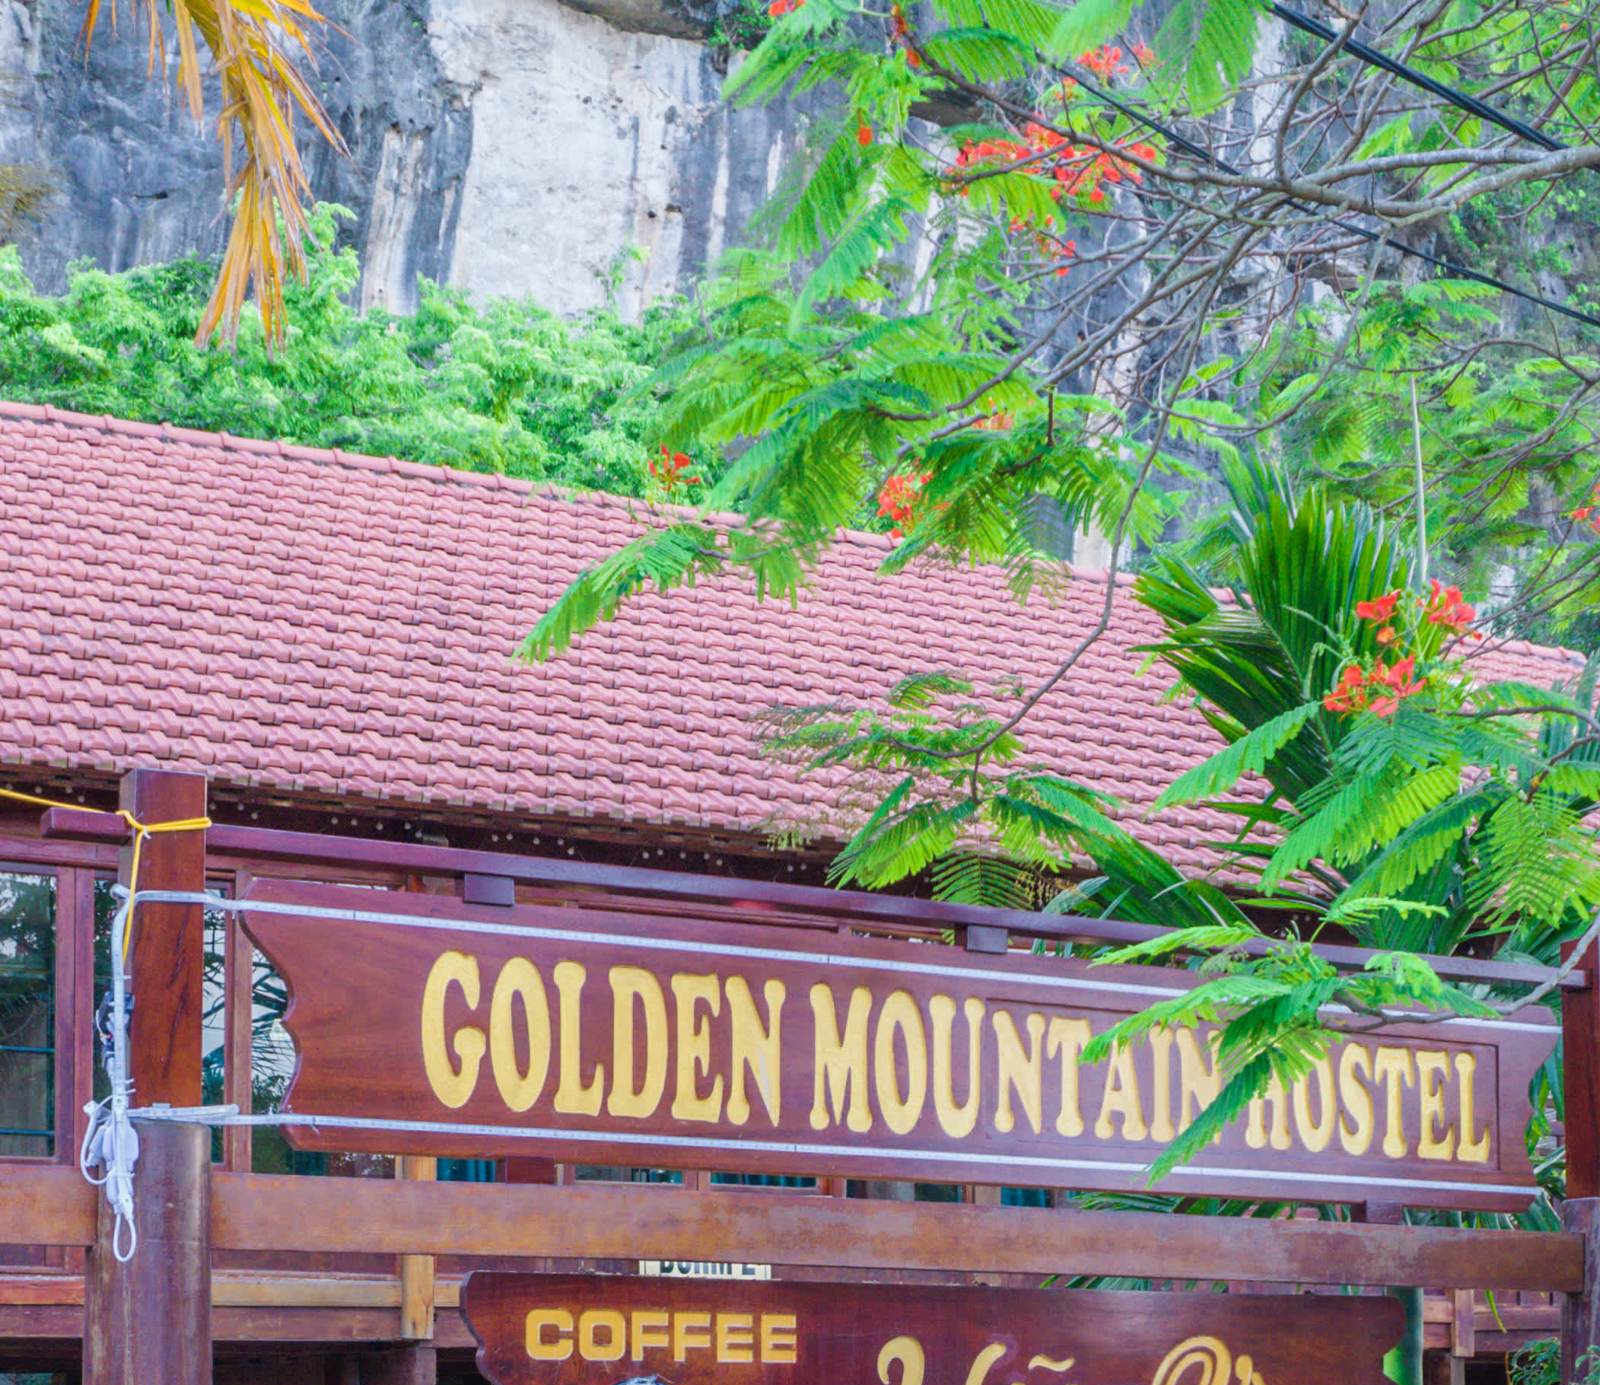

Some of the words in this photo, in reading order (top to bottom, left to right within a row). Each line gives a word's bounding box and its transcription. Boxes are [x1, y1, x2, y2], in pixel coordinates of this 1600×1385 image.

[422, 951, 785, 1127] GOLDEN
[809, 983, 1222, 1145] MOUNTAIN
[525, 1309, 797, 1363] COFFEE
